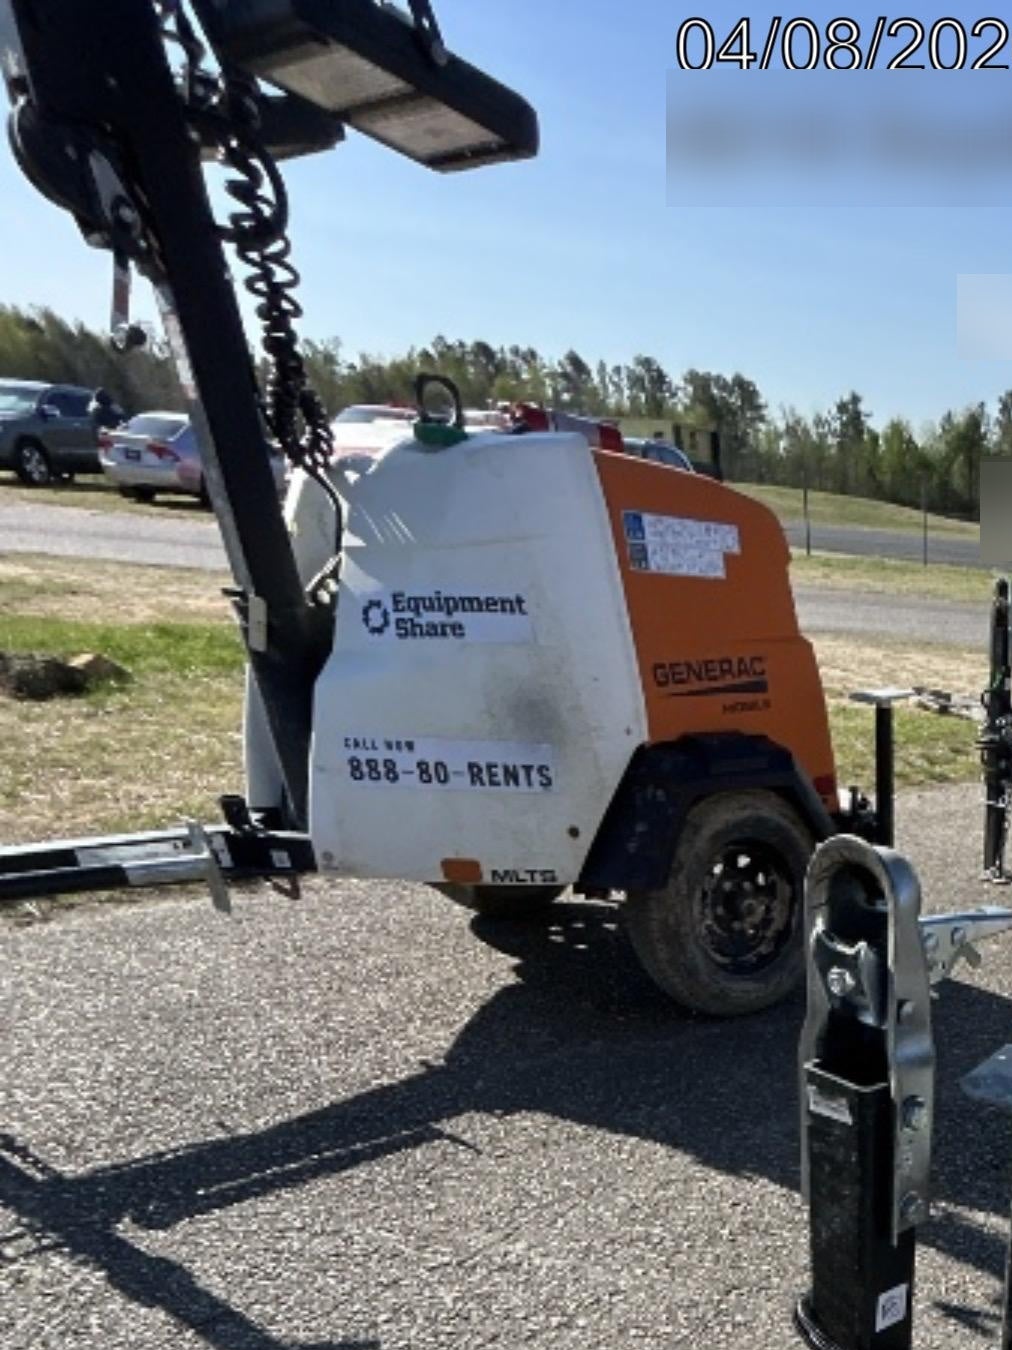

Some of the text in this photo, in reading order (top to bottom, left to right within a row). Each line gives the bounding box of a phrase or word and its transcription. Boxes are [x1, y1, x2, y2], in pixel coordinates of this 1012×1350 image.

[391, 590, 529, 617] Equipment
[394, 617, 466, 639] Share
[653, 656, 766, 687] GENERAC
[347, 756, 553, 790] 888-80-RENTS
[491, 869, 558, 883] MLTS
